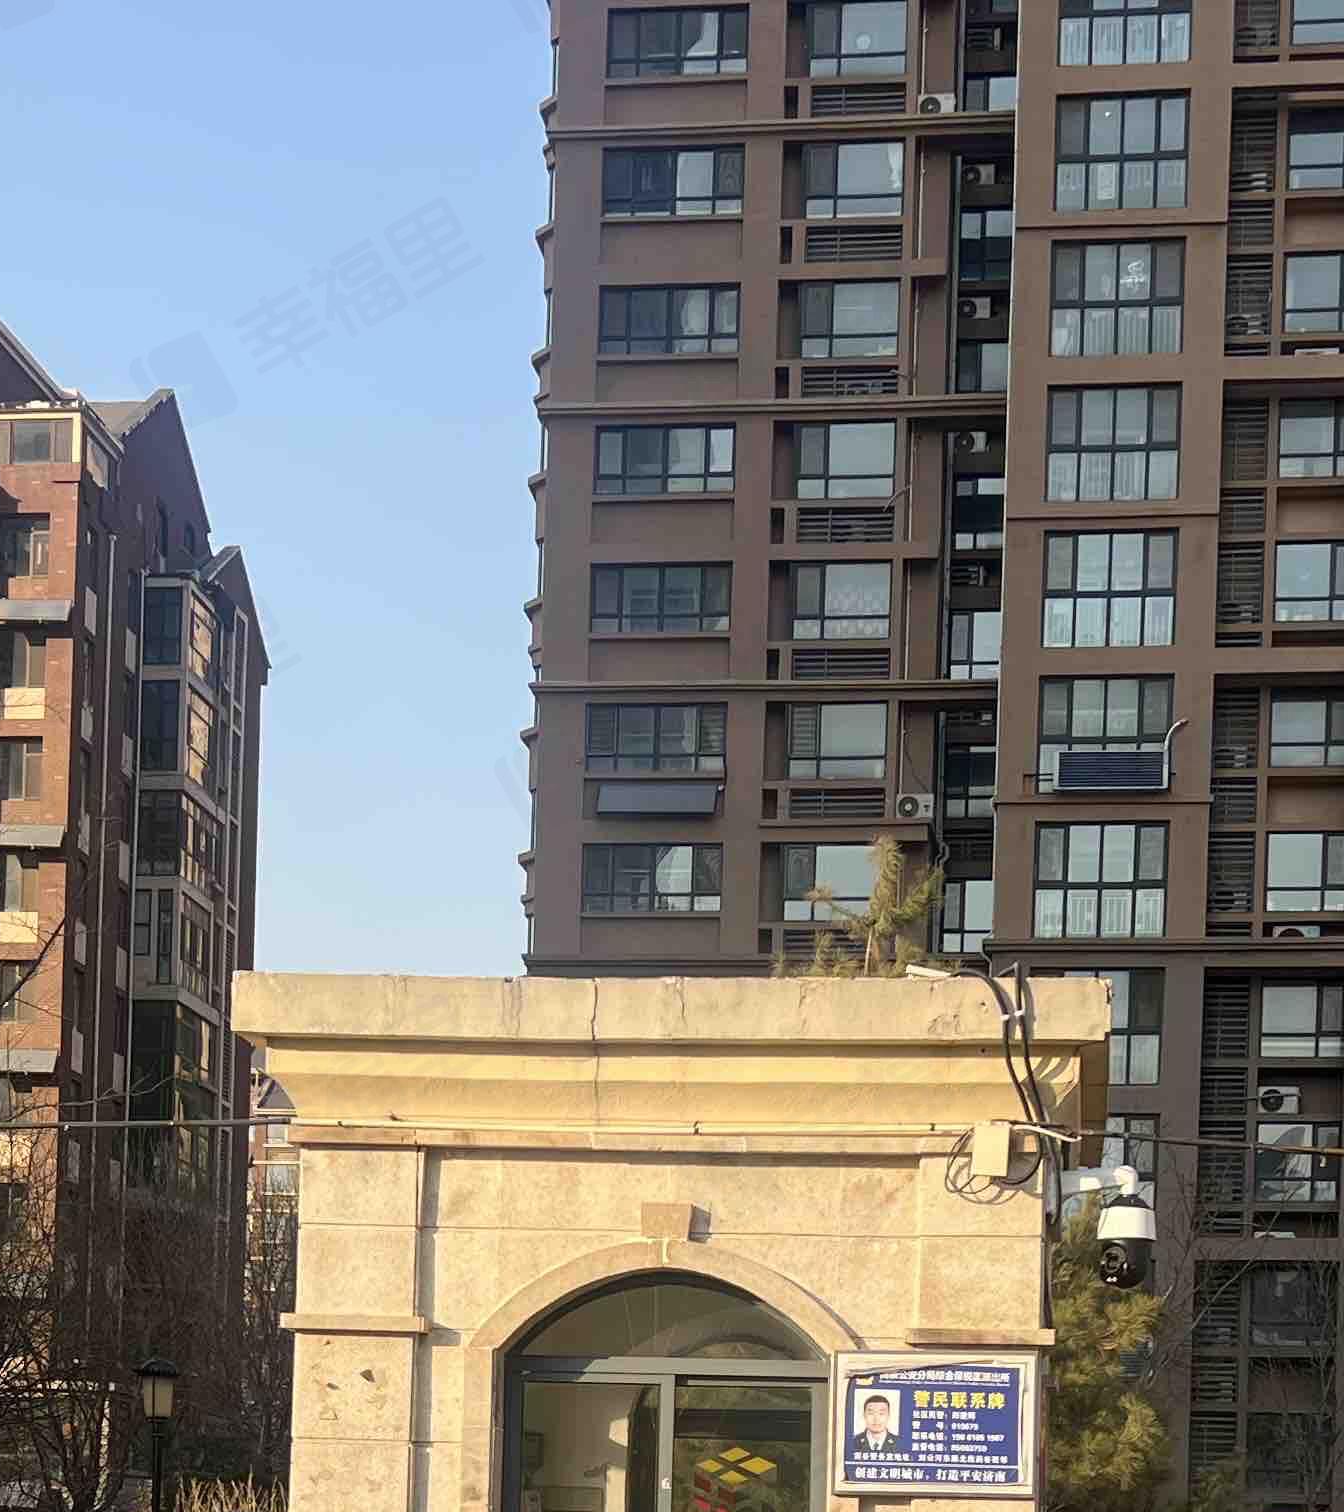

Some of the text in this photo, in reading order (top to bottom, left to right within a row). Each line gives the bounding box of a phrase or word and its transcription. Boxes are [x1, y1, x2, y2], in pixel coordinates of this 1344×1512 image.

[912, 1390, 1006, 1410] 警民联系牌
